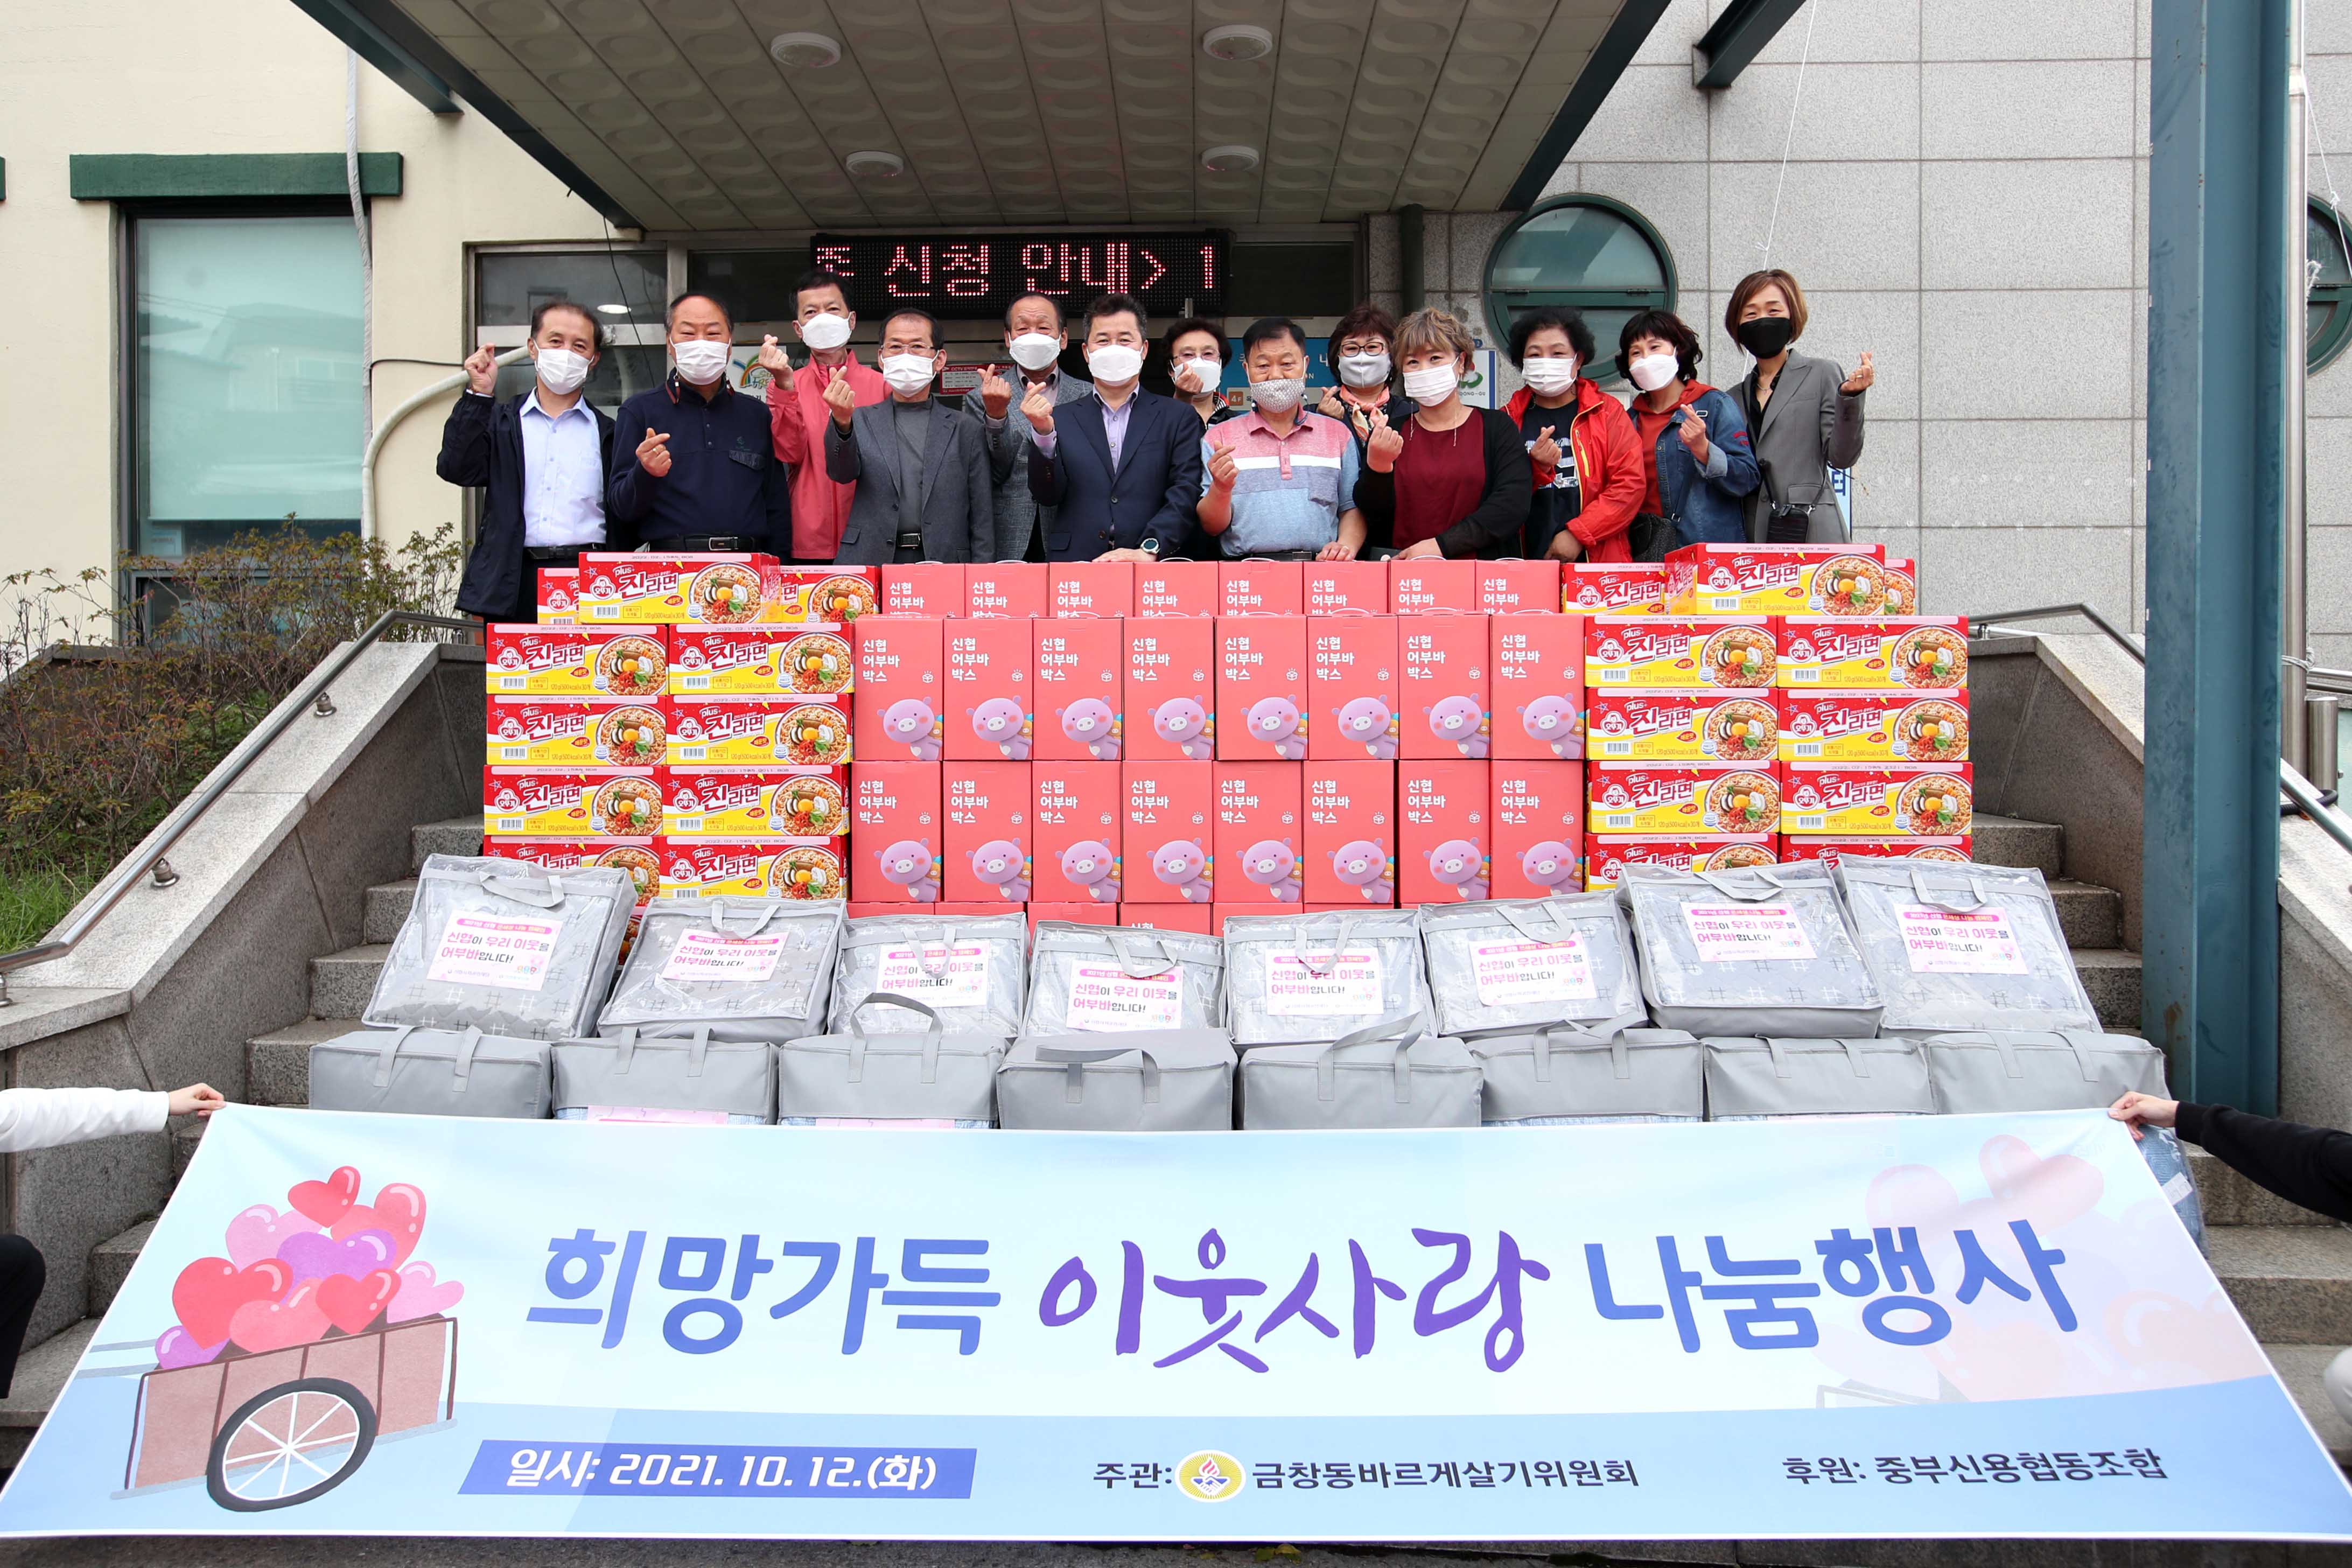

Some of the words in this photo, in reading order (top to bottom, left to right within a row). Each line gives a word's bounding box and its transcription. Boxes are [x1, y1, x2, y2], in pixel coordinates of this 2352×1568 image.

[884, 244, 989, 296] 신청
[1200, 246, 1213, 288] 1
[890, 582, 912, 595] 신협
[1057, 580, 1080, 594] 신협
[1226, 579, 1249, 593] 신협
[1398, 578, 1422, 591] 신협
[890, 597, 925, 609] 어부바
[1057, 595, 1093, 608] 어부바
[1227, 594, 1263, 607] 어부바
[1398, 593, 1435, 606] 어부바
[863, 639, 886, 653] 신협
[951, 637, 976, 651] 신협
[1041, 638, 1065, 652] 신협
[1132, 637, 1157, 652] 신협
[1225, 636, 1249, 650] 신협
[1316, 636, 1341, 650] 신협
[1407, 635, 1432, 649] 신협
[1501, 634, 1526, 648] 신협
[863, 655, 900, 668] 어부바
[951, 653, 990, 666] 어부바
[1041, 653, 1079, 667] 어부바
[1132, 653, 1171, 667] 어부바
[1225, 652, 1264, 666] 어부바
[1316, 652, 1355, 666] 어부바
[1407, 650, 1446, 664] 어부바
[1501, 650, 1541, 664] 어부바
[863, 670, 887, 683] 박스
[951, 668, 977, 682] 박스
[1041, 669, 1066, 682] 박스
[1132, 669, 1158, 682] 박스
[1225, 668, 1251, 681] 박스
[1316, 668, 1342, 681] 박스
[1407, 667, 1433, 680] 박스
[1501, 666, 1527, 680] 박스
[859, 780, 883, 794] 신협
[951, 780, 975, 794] 신협
[1040, 780, 1064, 794] 신협
[1131, 780, 1156, 794] 신협
[1221, 779, 1245, 793] 신협
[1312, 780, 1336, 794] 신협
[1408, 779, 1432, 793] 신협
[1501, 779, 1525, 794] 신협
[859, 796, 897, 809] 어부바
[951, 796, 989, 809] 어부바
[1040, 796, 1078, 809] 어부바
[1131, 795, 1170, 809] 어부바
[1221, 795, 1259, 809] 어부바
[1312, 796, 1350, 809] 어부바
[1408, 795, 1446, 808] 어부바
[1501, 795, 1540, 809] 어부바
[859, 811, 884, 824] 박스
[951, 811, 976, 824] 박스
[1040, 811, 1065, 824] 박스
[1131, 811, 1157, 824] 박스
[1221, 811, 1247, 824] 박스
[1312, 811, 1338, 824] 박스
[1408, 810, 1433, 824] 박스
[1501, 811, 1527, 825] 박스
[527, 1229, 1001, 1355] 희망가득
[1039, 1228, 1550, 1373] 이웃사랑
[1584, 1219, 2078, 1353] 나눔행사
[507, 1449, 601, 1487] 일시:
[610, 1454, 723, 1485] 2021.
[739, 1455, 793, 1486] 10.
[809, 1455, 936, 1490] 12.(화)
[1782, 1457, 1866, 1485] 후원:
[1874, 1448, 2168, 1484] 중부신용협동조합
[1093, 1462, 1173, 1489] 주관:
[1252, 1460, 1639, 1489] 금창동바르게살기위원회
